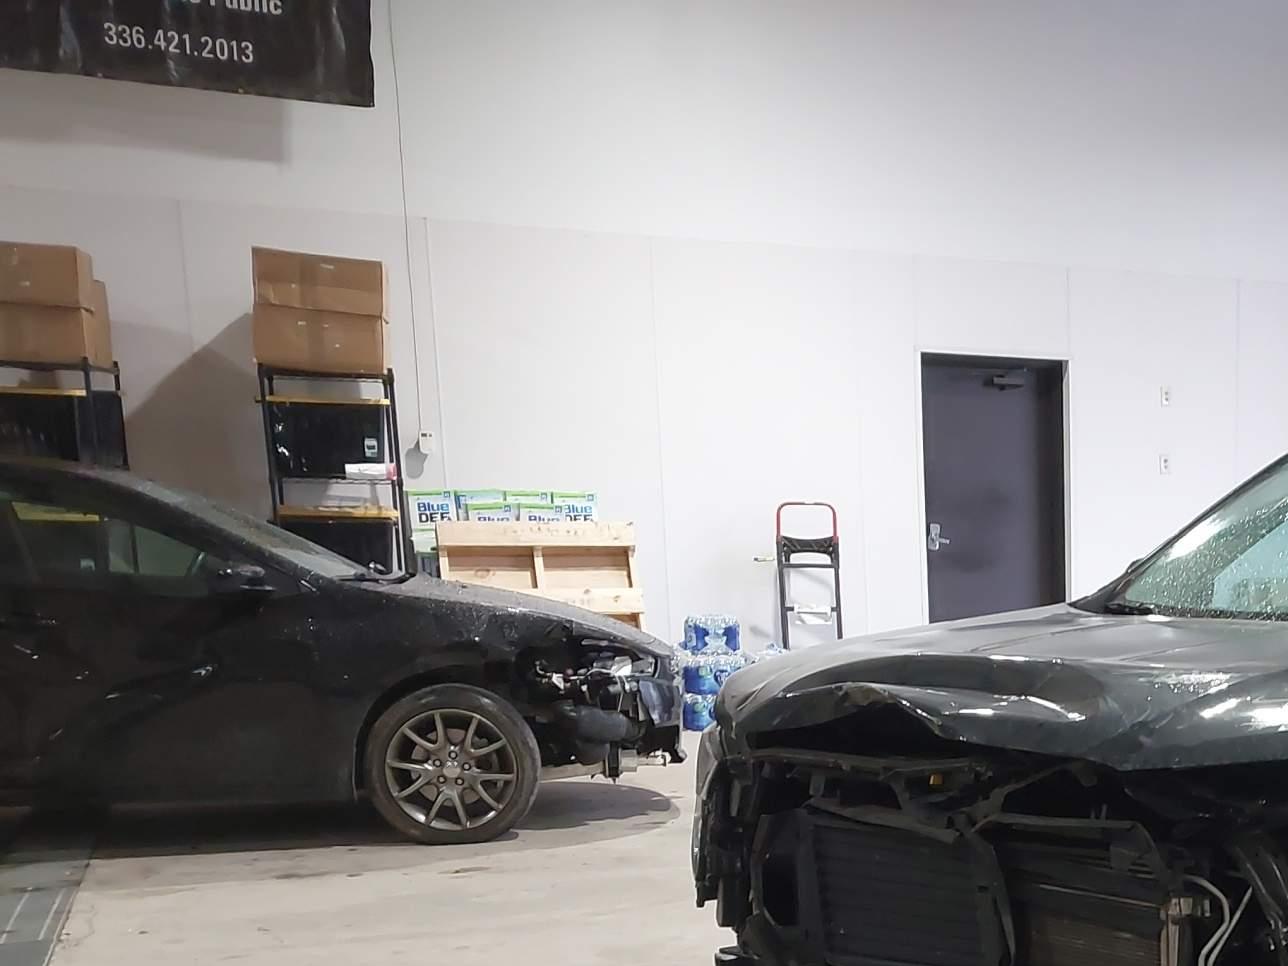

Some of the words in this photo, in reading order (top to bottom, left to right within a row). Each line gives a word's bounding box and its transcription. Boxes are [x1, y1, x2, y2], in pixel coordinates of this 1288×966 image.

[209, 0, 282, 15] ublic
[103, 22, 254, 63] 336.421.2013
[416, 502, 450, 512] Blue
[418, 512, 450, 523] DEF
